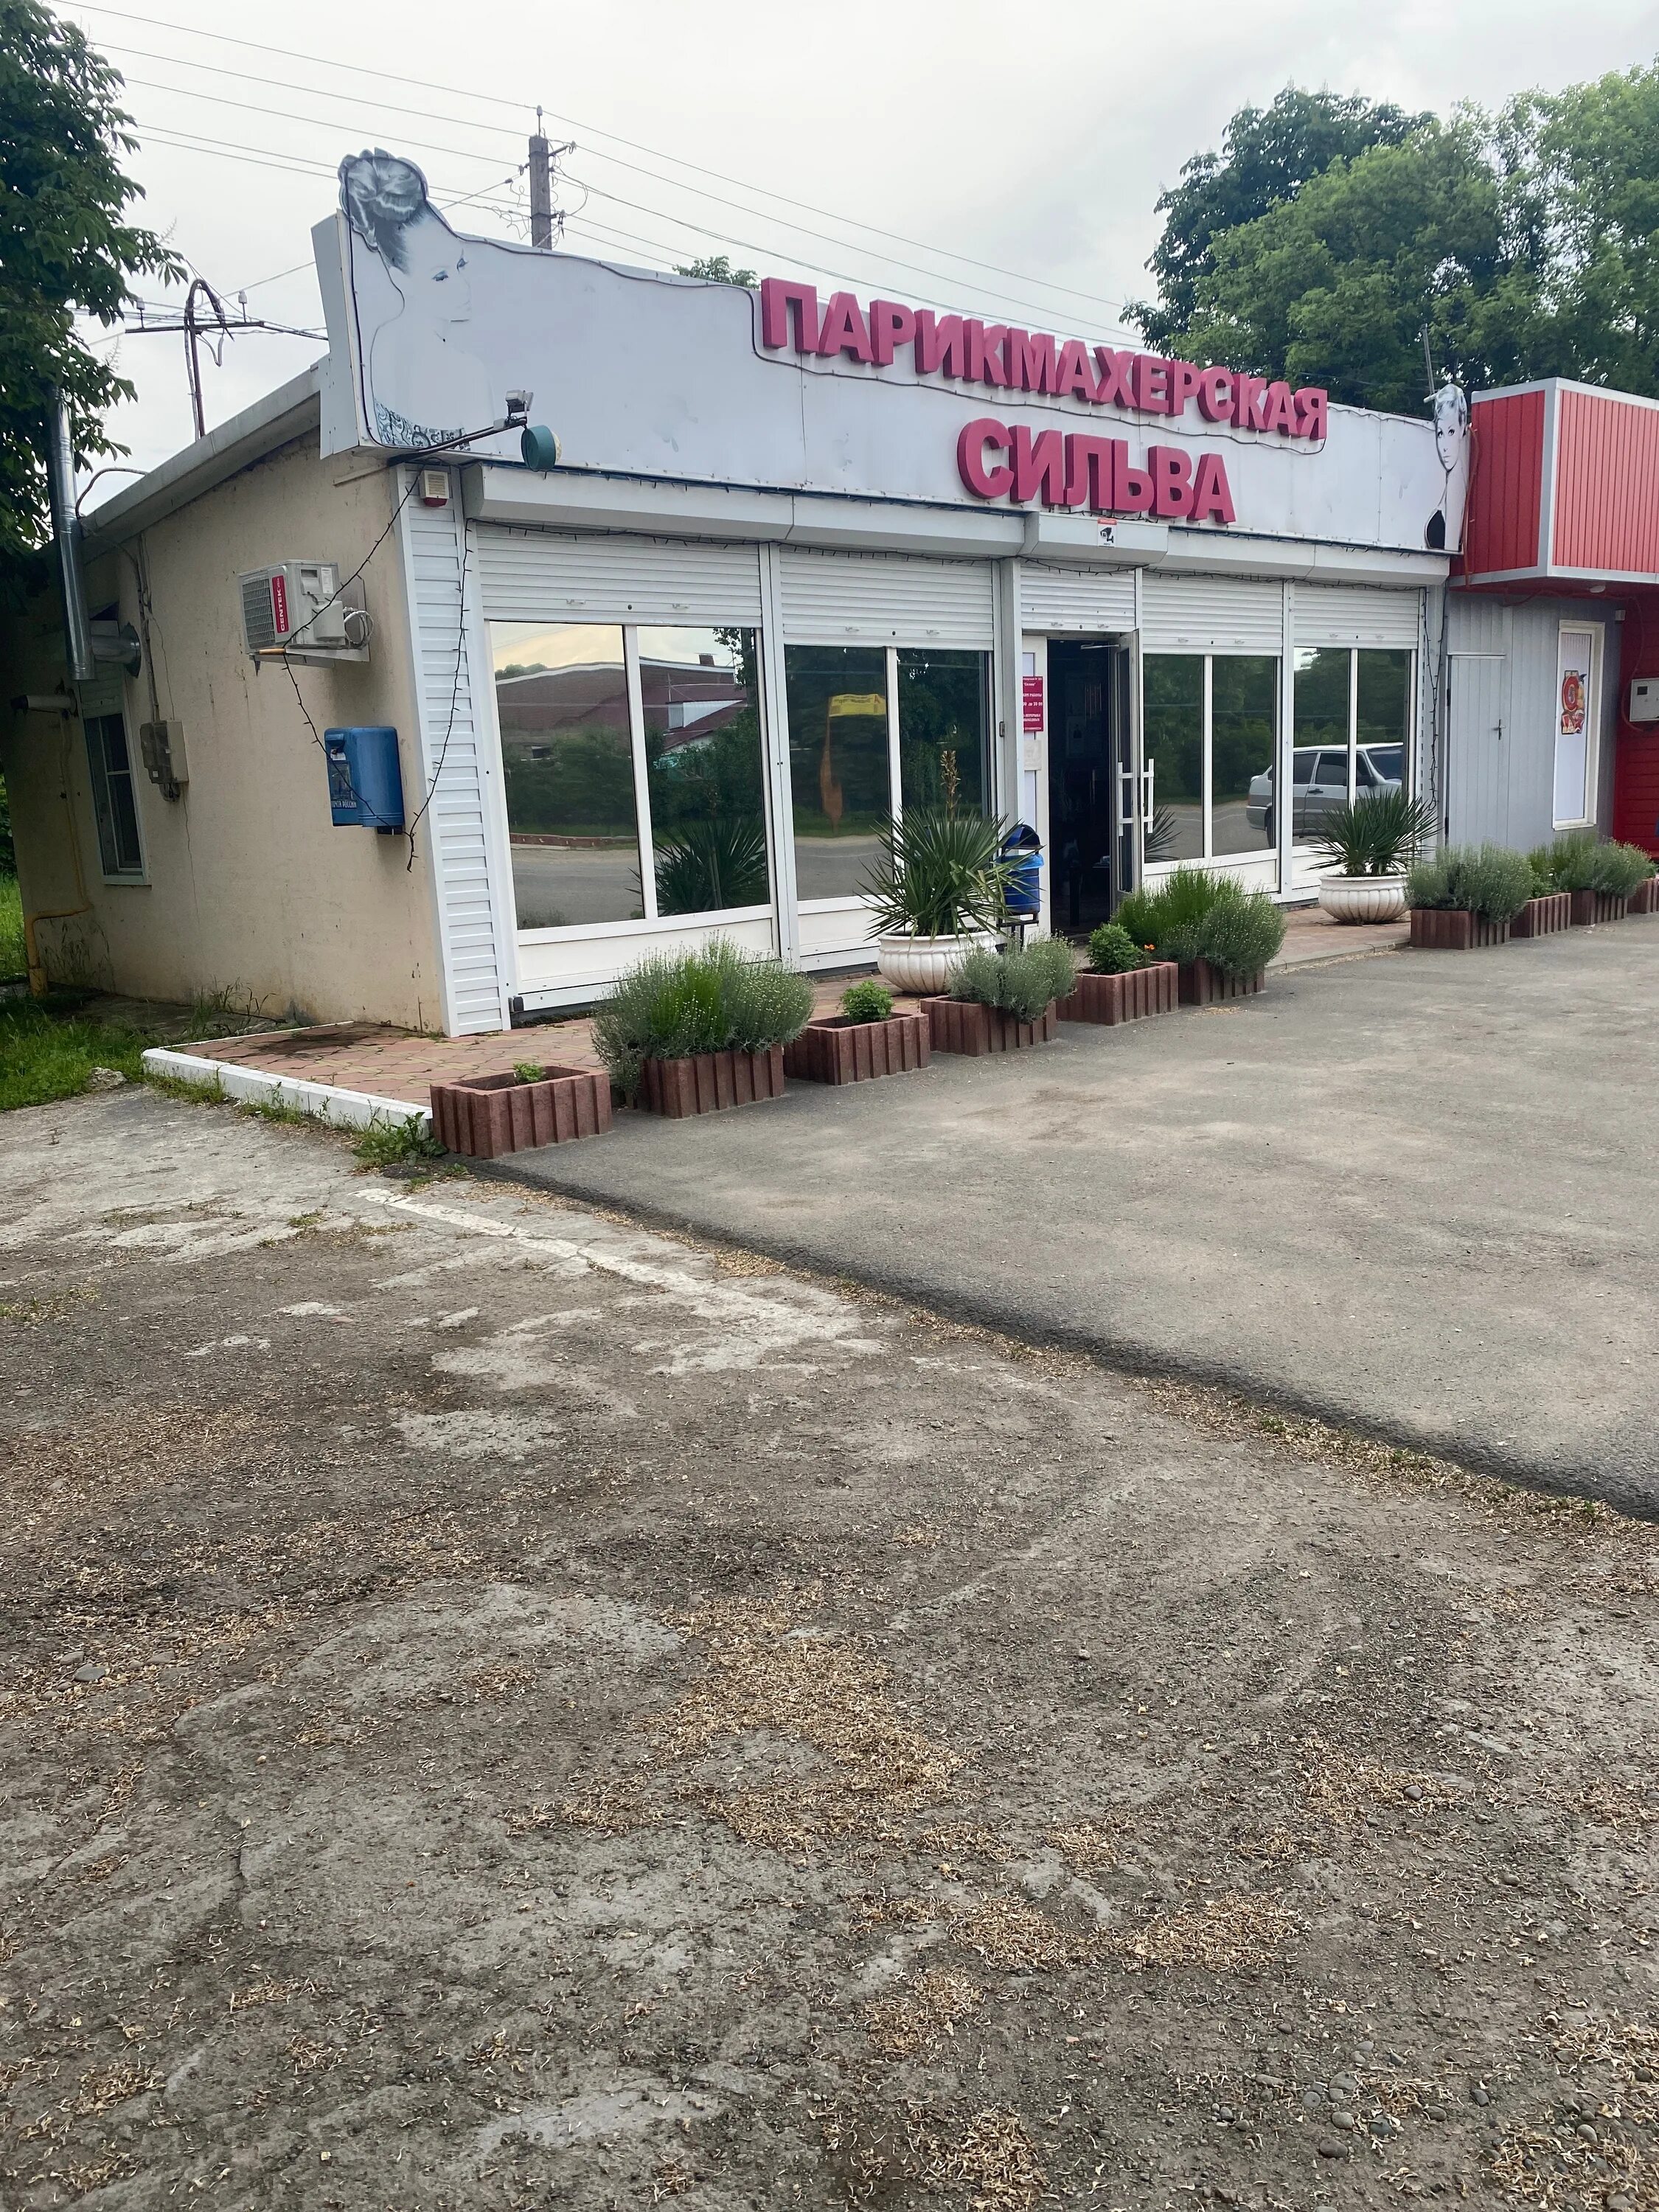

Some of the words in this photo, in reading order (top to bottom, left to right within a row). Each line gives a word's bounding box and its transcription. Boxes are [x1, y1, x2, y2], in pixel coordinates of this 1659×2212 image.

[761, 276, 1327, 441] ПАРИКМАХЕРСКАЯ
[957, 417, 1236, 524] СИЛЬВА
[277, 588, 285, 631] CENTEK
